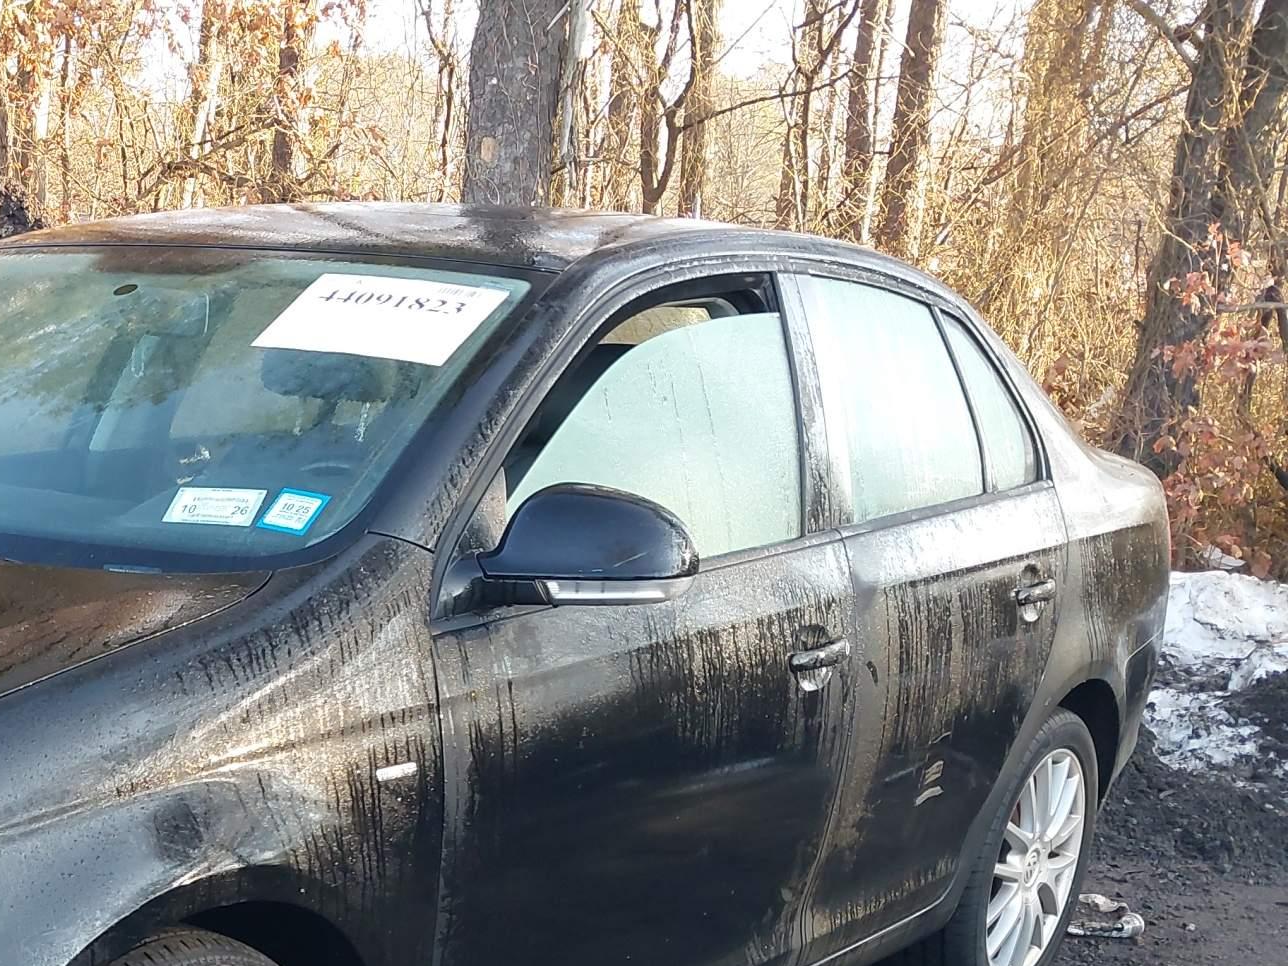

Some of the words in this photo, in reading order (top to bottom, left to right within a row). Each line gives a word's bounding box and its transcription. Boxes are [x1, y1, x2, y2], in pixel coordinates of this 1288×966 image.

[319, 289, 467, 315] 44091823
[181, 504, 197, 514] 10
[231, 505, 249, 516] 26
[281, 502, 295, 511] 10
[296, 505, 311, 514] 25
